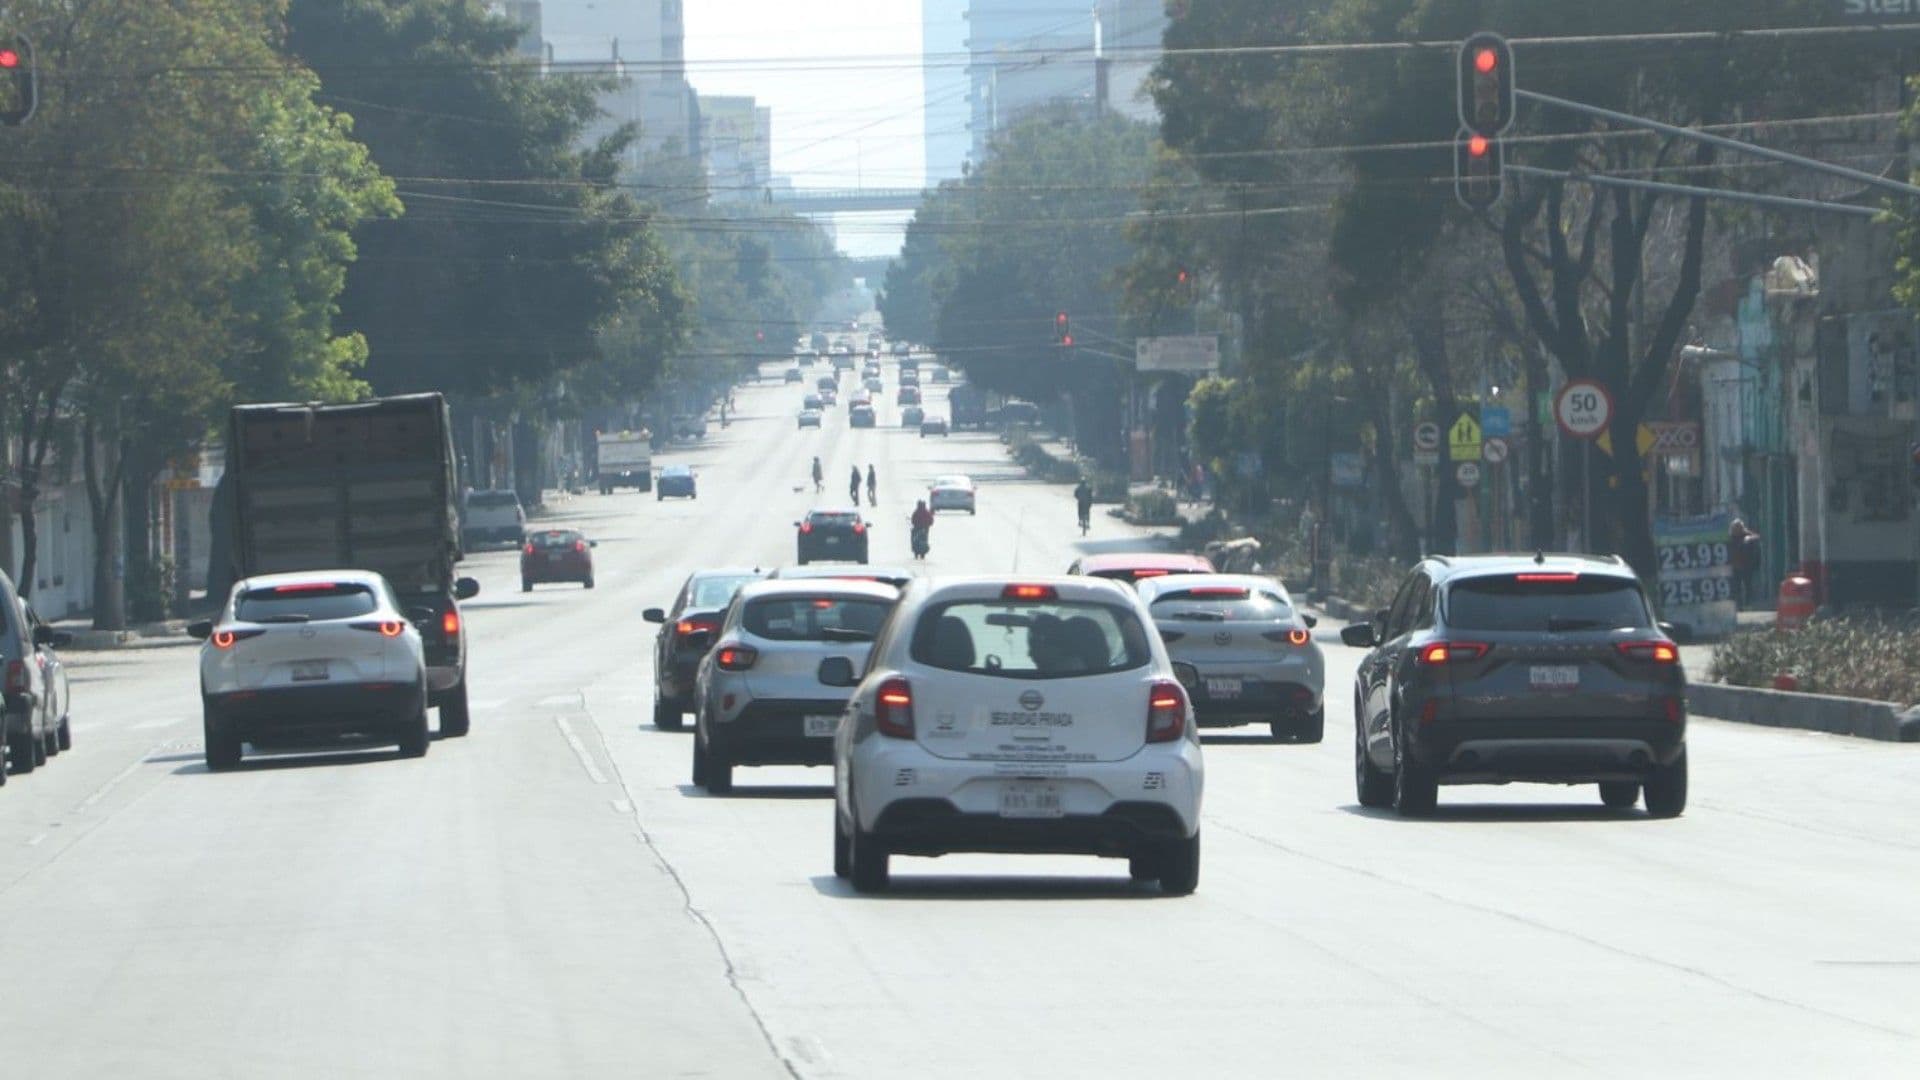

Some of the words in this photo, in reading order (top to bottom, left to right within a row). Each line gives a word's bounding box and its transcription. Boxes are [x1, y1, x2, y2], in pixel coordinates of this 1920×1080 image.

[1571, 393, 1597, 412] 50
[1570, 414, 1598, 425] km/h
[1661, 543, 1728, 569] 23.99
[1664, 579, 1730, 604] 25.99
[990, 711, 1038, 726] SEGURIDAD
[1040, 711, 1073, 727] PRIVADA
